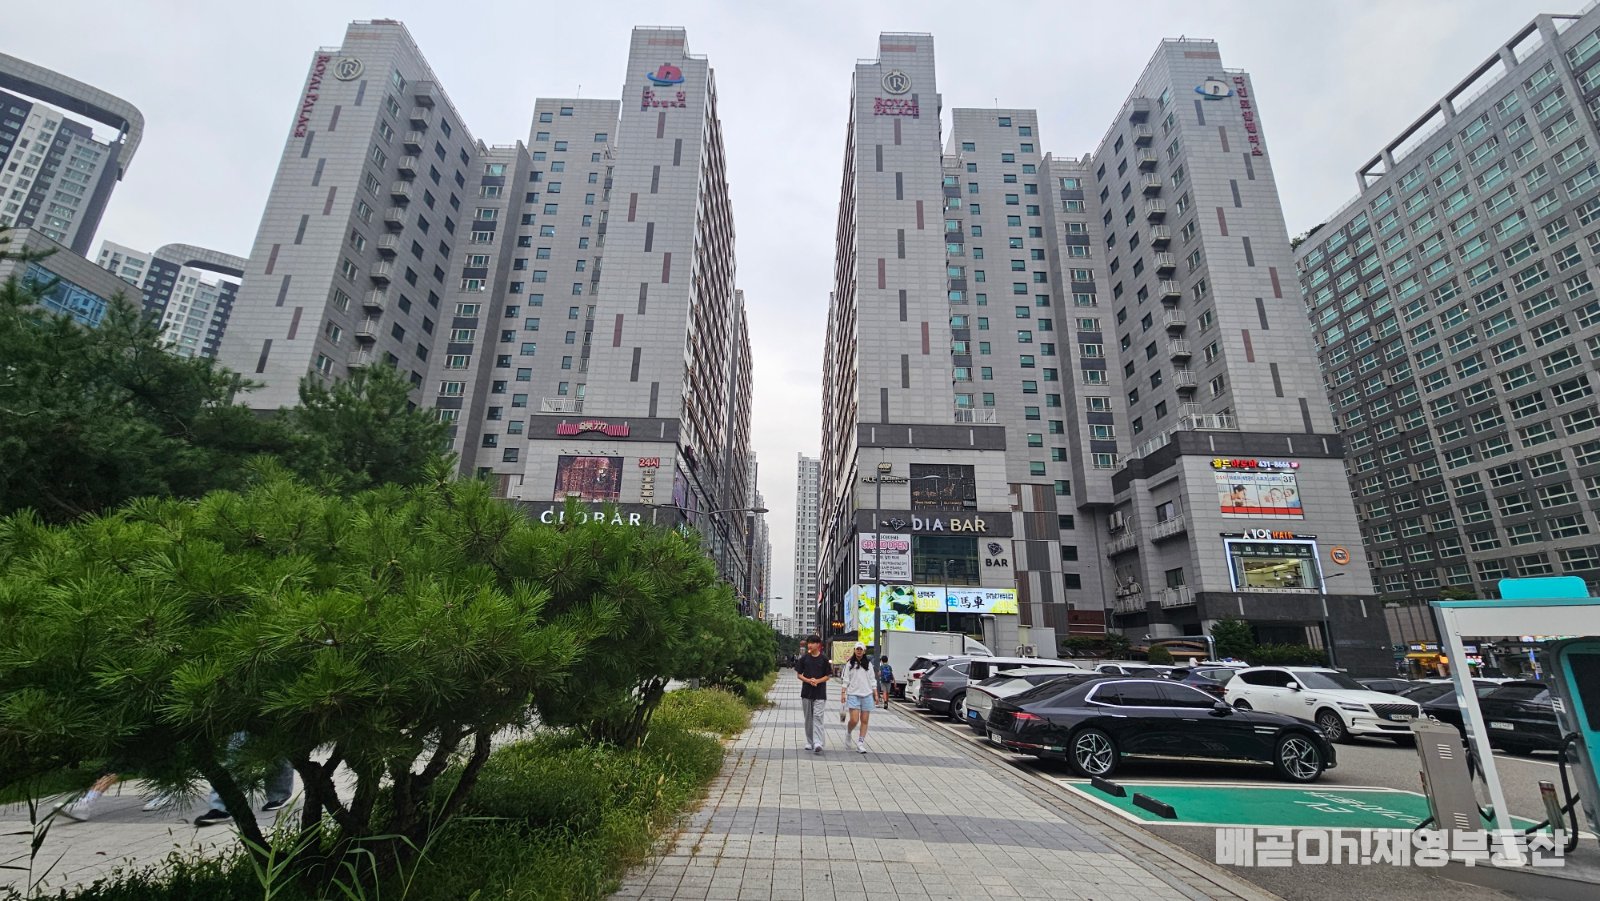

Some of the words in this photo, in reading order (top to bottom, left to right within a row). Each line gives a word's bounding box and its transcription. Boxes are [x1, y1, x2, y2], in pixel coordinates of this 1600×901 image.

[307, 55, 331, 93] ROYAL
[294, 94, 319, 138] PALACE
[639, 457, 660, 468] 24시
[912, 517, 944, 531] DIA
[950, 518, 986, 532] BAR
[888, 542, 907, 550] OPEN
[985, 559, 1008, 567] BAR
